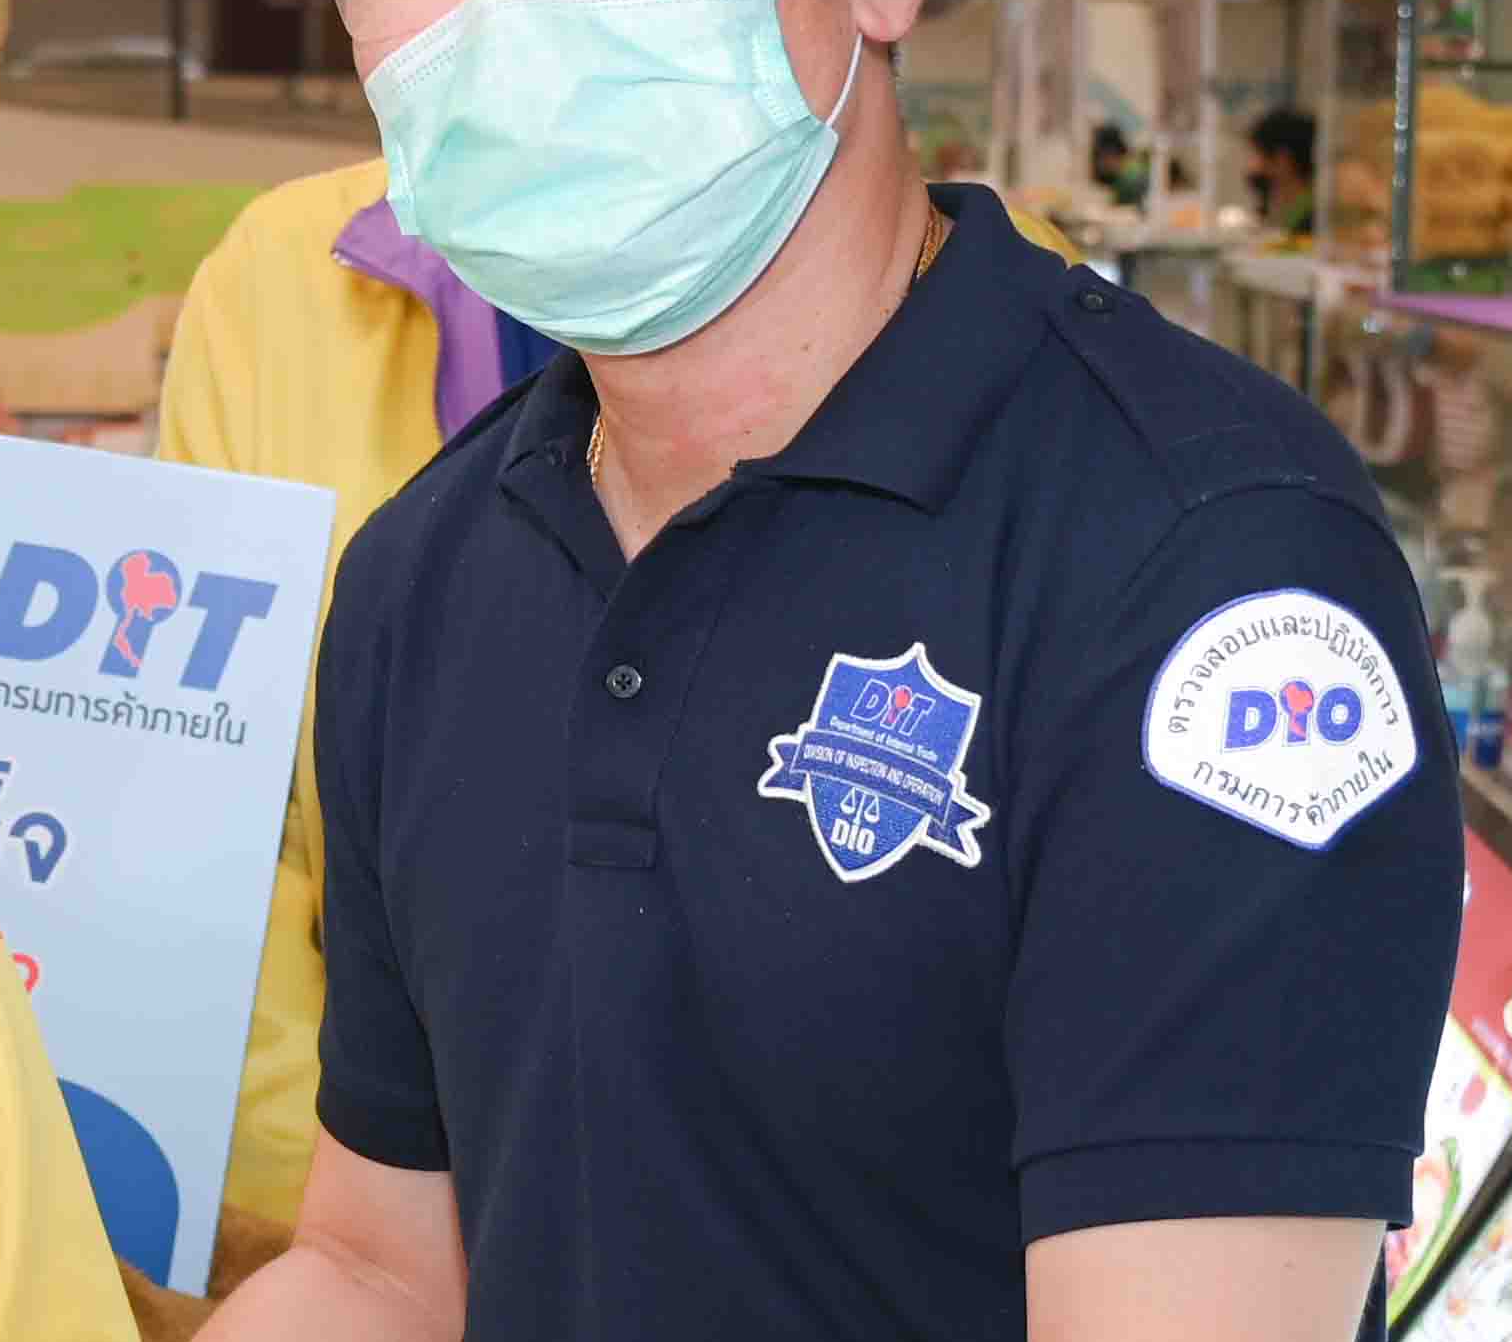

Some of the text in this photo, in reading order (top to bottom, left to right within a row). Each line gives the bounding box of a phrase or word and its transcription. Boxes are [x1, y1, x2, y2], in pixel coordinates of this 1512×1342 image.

[1167, 612, 1400, 735] ตรวจสอบและปฏิบัติการ
[829, 714, 874, 743] Department
[886, 735, 915, 756] Internal
[916, 743, 939, 762] Trade
[850, 678, 937, 737] DIT
[1223, 677, 1364, 750] DIO
[803, 743, 834, 763] DIVISION
[846, 753, 888, 779] INSPECTION
[903, 771, 945, 806] OPERATION
[1193, 748, 1394, 827] กรมการค้าภายใน
[830, 817, 876, 856] DIO
